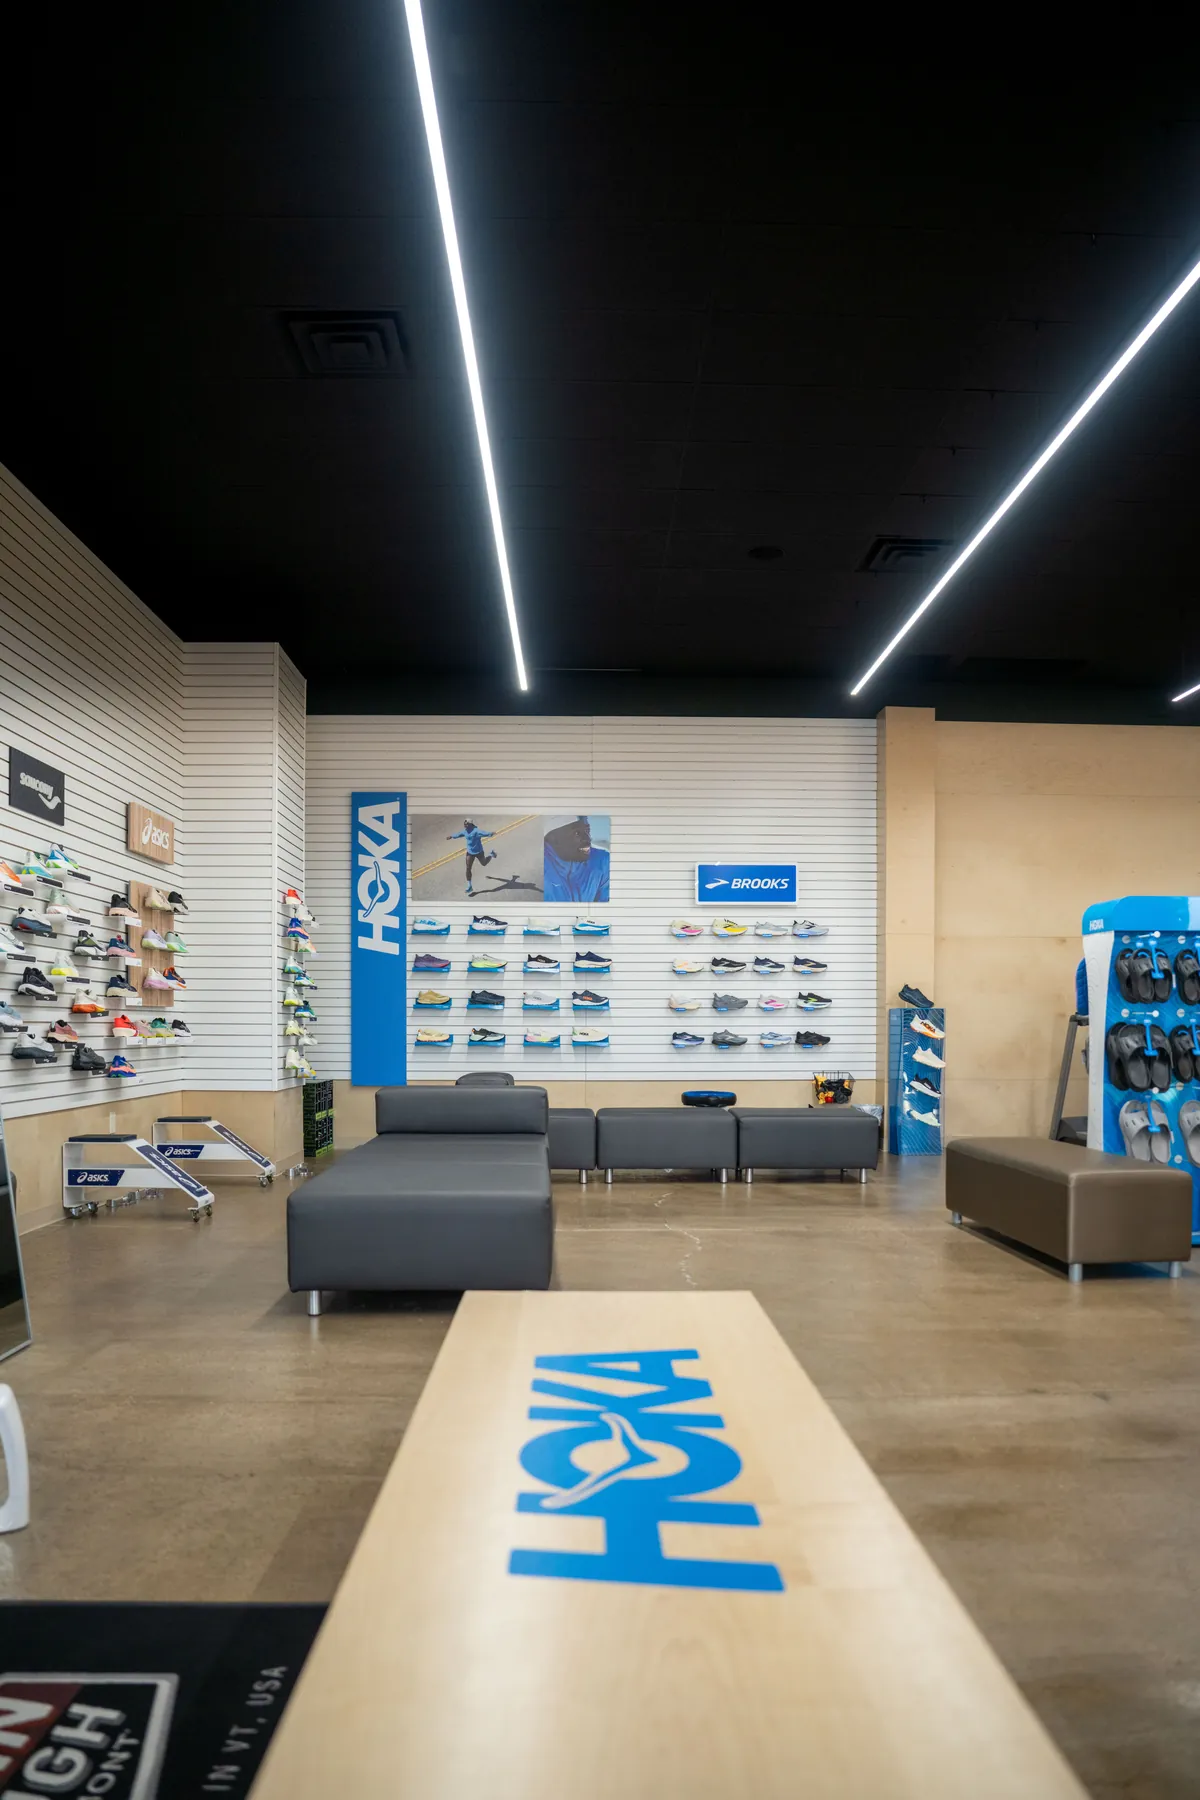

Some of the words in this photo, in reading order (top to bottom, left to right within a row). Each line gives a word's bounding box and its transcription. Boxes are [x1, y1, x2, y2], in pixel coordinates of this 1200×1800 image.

[357, 801, 400, 956] HOKA
[731, 878, 790, 889] BROOKS
[87, 1174, 109, 1182] asics
[507, 1349, 786, 1592] HOKA
[245, 1666, 289, 1706] USA
